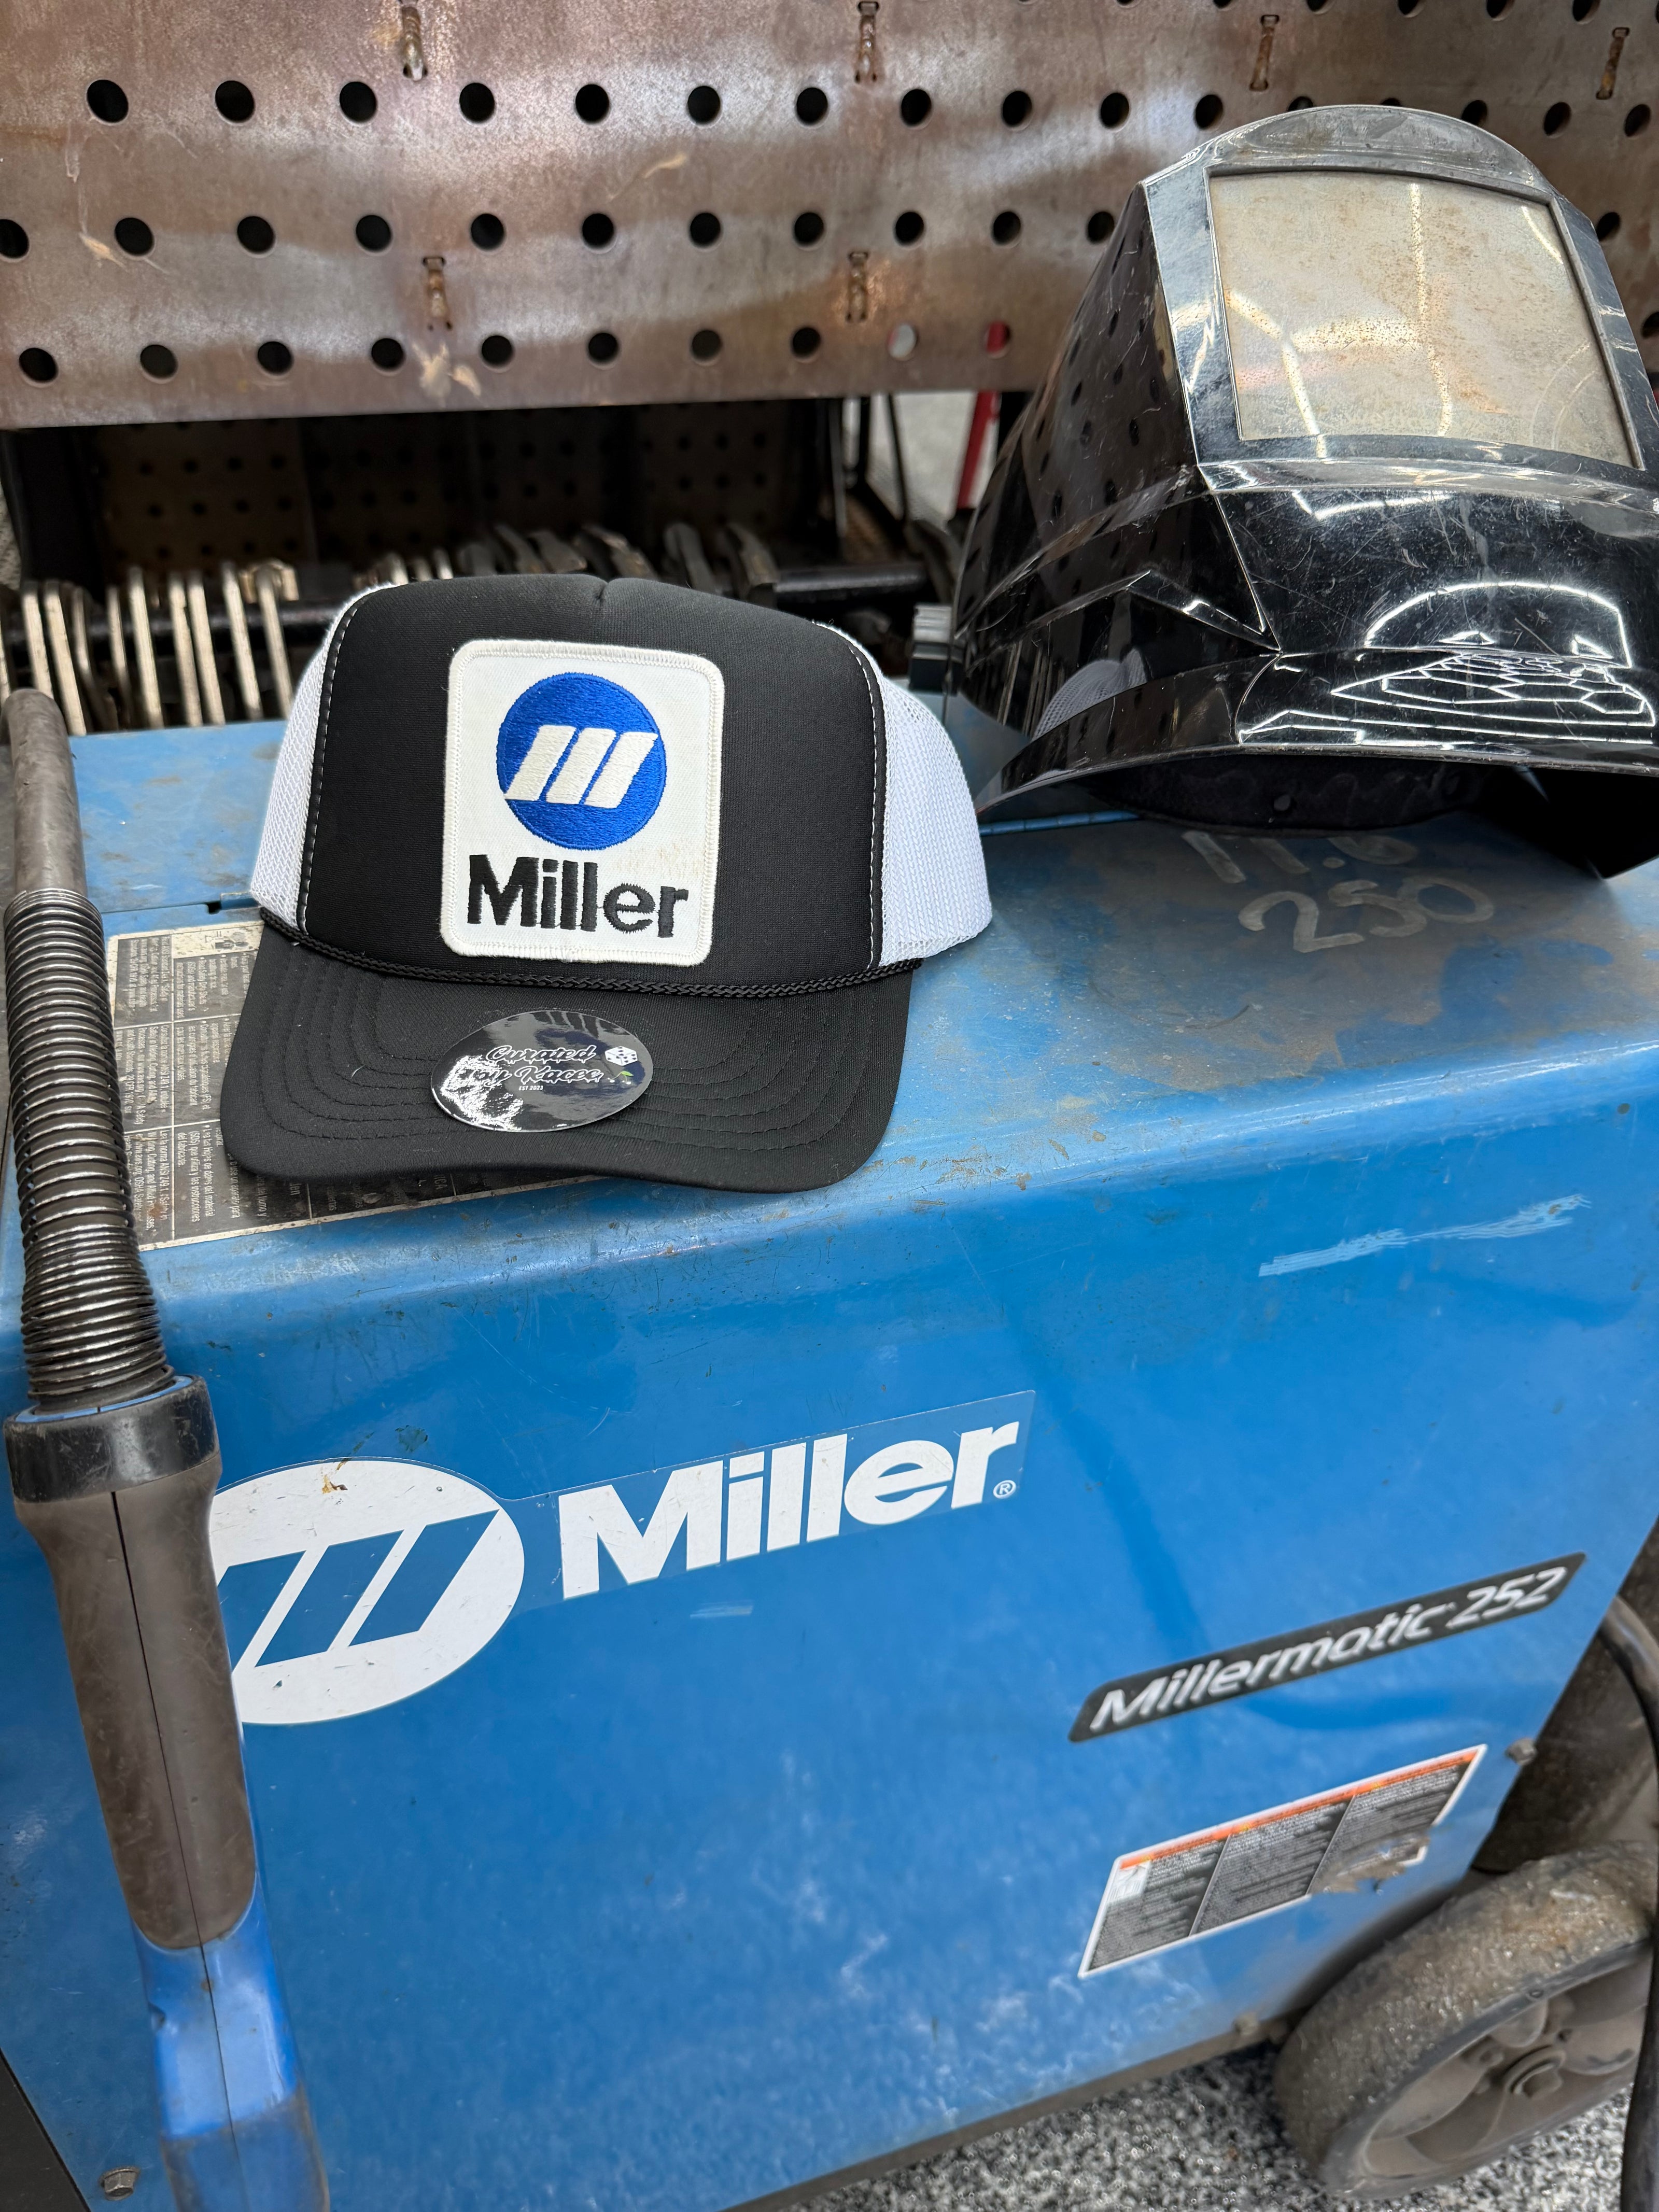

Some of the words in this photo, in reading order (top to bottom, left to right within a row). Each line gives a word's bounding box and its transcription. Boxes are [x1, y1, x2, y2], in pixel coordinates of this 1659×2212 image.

[467, 854, 688, 937] Miller
[1238, 876, 1494, 953] 250
[485, 1045, 597, 1064] Curated
[514, 1066, 604, 1085] Kacee
[124, 1081, 135, 1091] CFR
[200, 1094, 212, 1104] (FS)
[134, 1109, 146, 1125] Safety
[188, 1131, 201, 1146] (SDS)
[160, 1145, 168, 1162] norma
[177, 1140, 188, 1167] fabricante.
[188, 1146, 199, 1156] que
[160, 1163, 170, 1176] ANSI
[204, 1170, 214, 1185] datos
[230, 1166, 239, 1176] use
[134, 1176, 145, 1193] OSHA
[147, 1174, 157, 1184] and
[190, 1176, 201, 1185] las
[204, 1186, 215, 1194] del
[133, 1193, 145, 1211] Safety
[191, 1186, 202, 1222] instrucciones
[205, 1195, 216, 1217] material
[229, 1206, 241, 1218] para
[1090, 1603, 1446, 1732] Millermatic
[1445, 1566, 1568, 1630] 252
